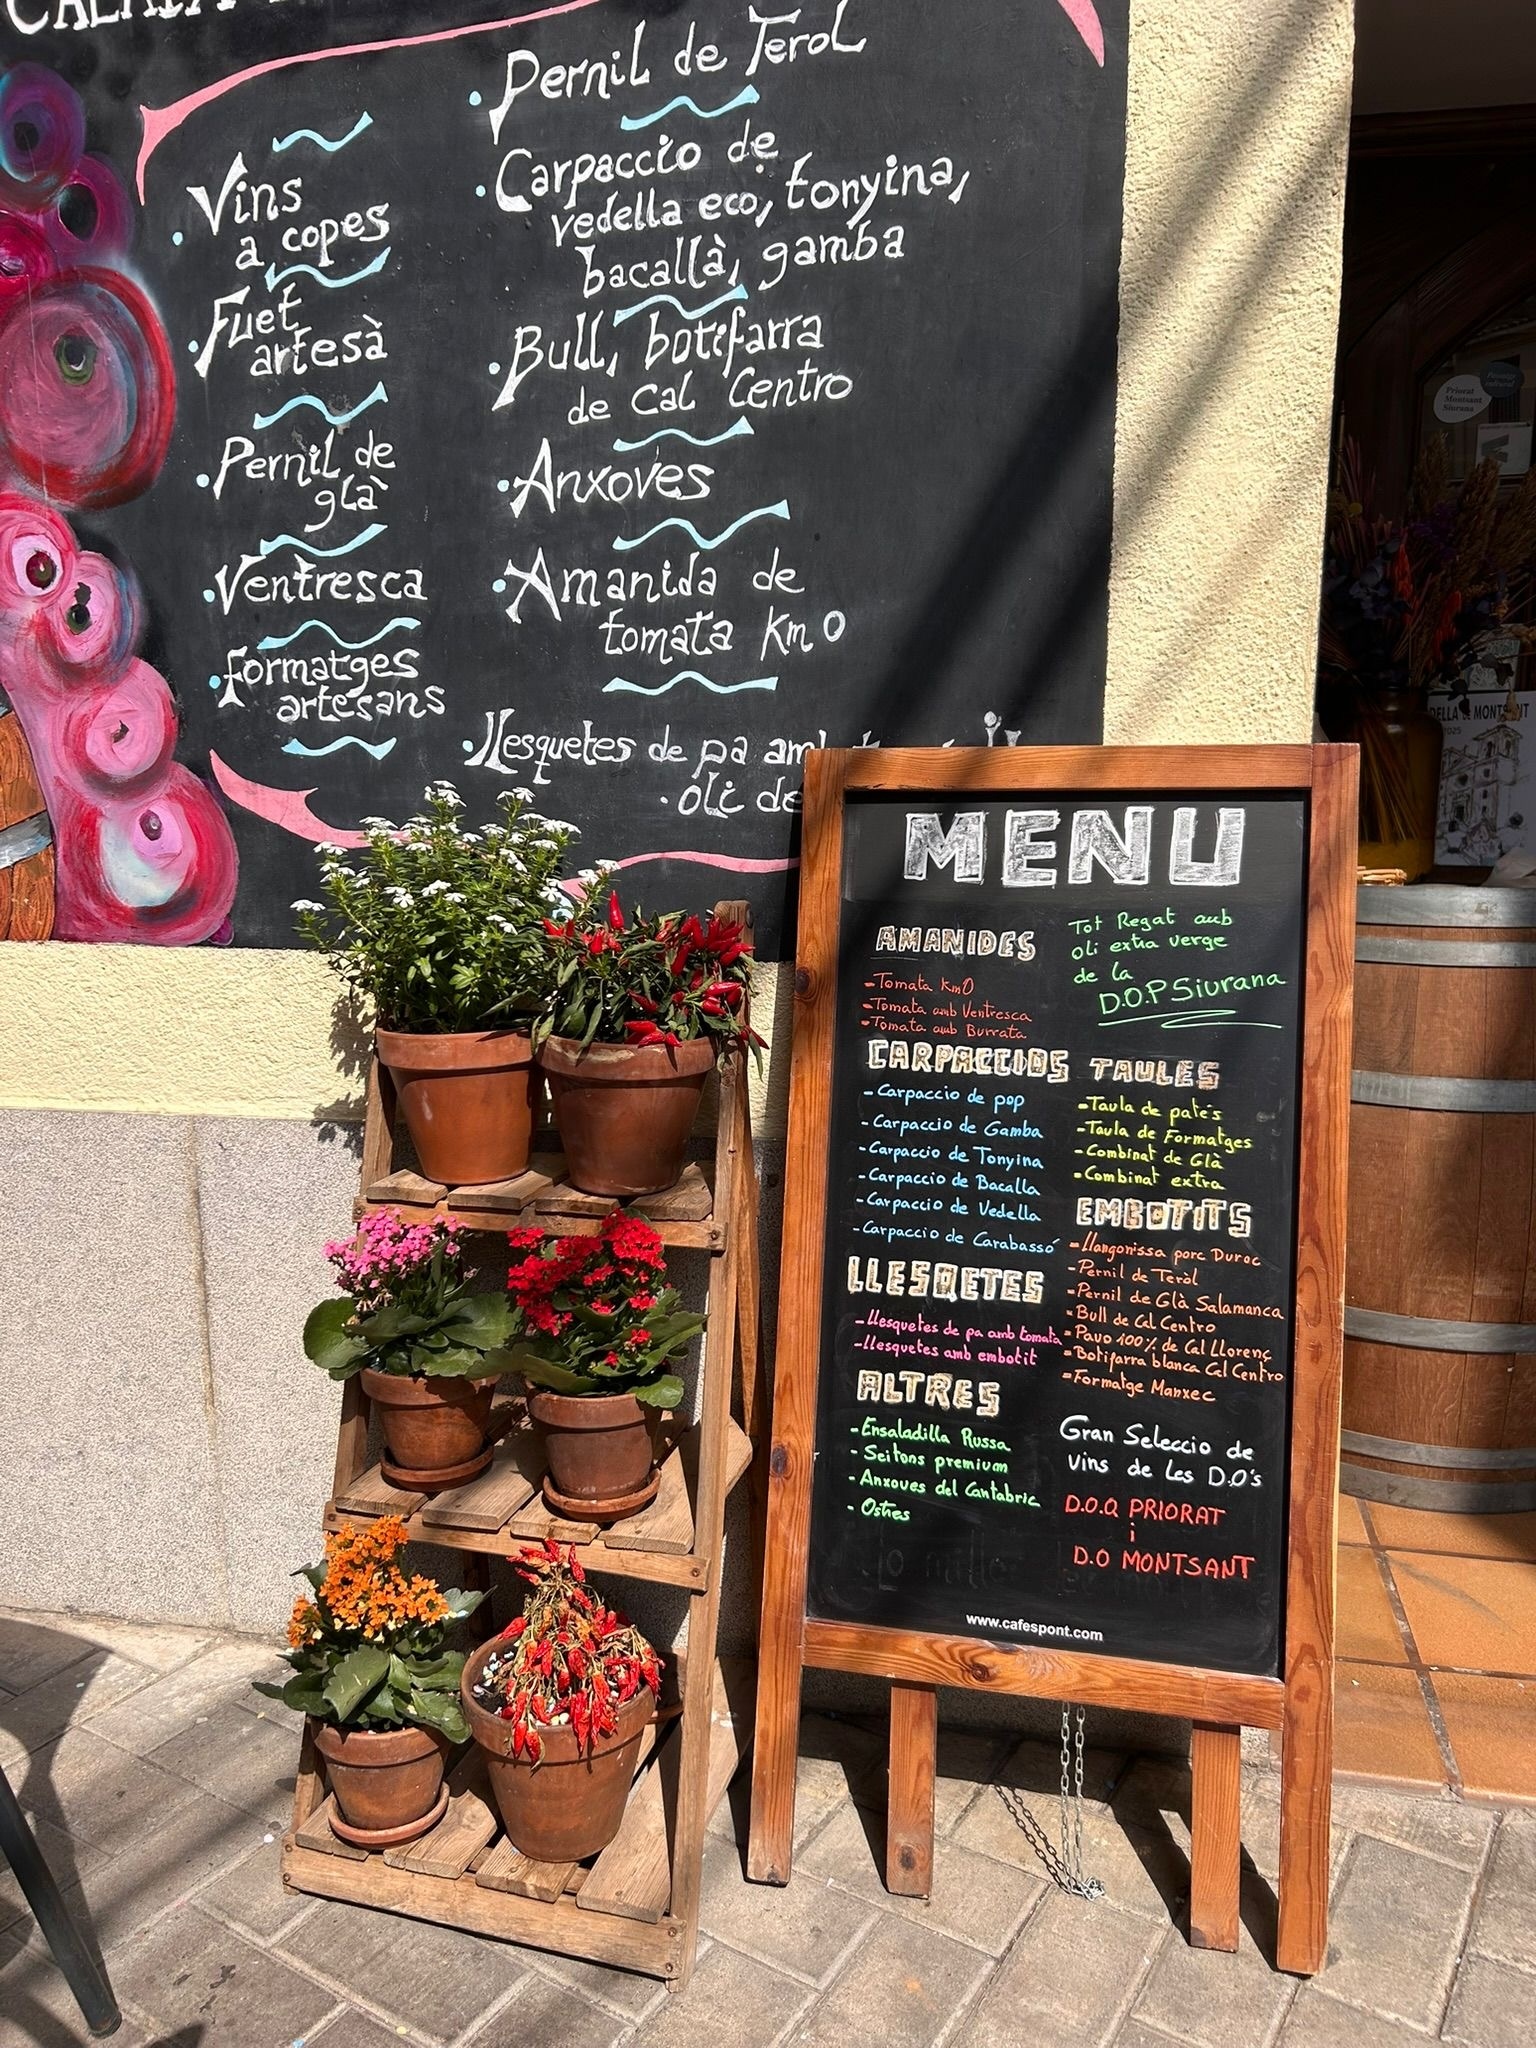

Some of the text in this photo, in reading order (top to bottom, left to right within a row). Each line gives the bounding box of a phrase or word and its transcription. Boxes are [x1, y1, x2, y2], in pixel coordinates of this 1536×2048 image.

[673, 20, 727, 76] de
[495, 118, 779, 212] Carpaccio de
[186, 151, 302, 235] Vins
[550, 188, 683, 247] vedella
[234, 201, 391, 270] a copes
[758, 218, 905, 291] gamba
[194, 281, 303, 377] Fuet
[644, 304, 824, 378] botifarra
[249, 313, 388, 377] artesà
[567, 385, 612, 425] de
[727, 357, 853, 409] Centro
[211, 427, 396, 500] Pernil de
[508, 437, 714, 518] Anxoves
[302, 472, 389, 532] glà
[213, 553, 428, 615] Ventresca
[503, 546, 805, 624] Amanida de
[598, 607, 733, 664] tomata
[275, 684, 446, 722] artesans
[647, 724, 688, 763] de
[694, 735, 748, 779] pa
[902, 805, 1246, 888] MENU
[1067, 915, 1102, 934] Tot
[1116, 906, 1175, 931] Regat
[875, 925, 1036, 961] AMANIDES
[1109, 933, 1159, 952] extra
[1168, 934, 1228, 951] verge
[1072, 961, 1133, 983] de la
[961, 999, 1032, 1023] Ventresca
[966, 1021, 1027, 1039] Burrata
[867, 1038, 1069, 1083] CARPACCIOS
[1088, 1057, 1219, 1090] TAULES
[966, 1087, 986, 1104] de
[993, 1094, 1025, 1114] pop
[1140, 1100, 1162, 1117] de
[958, 1115, 977, 1134] de
[983, 1119, 1043, 1139] Gamba
[1136, 1124, 1155, 1139] de
[1162, 1125, 1254, 1153] Formatges
[947, 1144, 969, 1163] de
[972, 1145, 1044, 1171] Tonyina
[1162, 1149, 1183, 1165] de
[951, 1171, 969, 1188] de
[975, 1173, 1040, 1196] Bacalla
[1169, 1170, 1226, 1190] extra
[949, 1196, 969, 1215] de
[978, 1199, 1041, 1222] Vedella
[1075, 1196, 1251, 1238] EMBOTITS
[944, 1227, 964, 1244] de
[1173, 1248, 1206, 1265] porc
[1210, 1247, 1261, 1267] Duroc
[846, 1255, 1044, 1304] LLESQETES
[1130, 1269, 1148, 1283] de
[1129, 1291, 1151, 1305] de
[1154, 1291, 1189, 1309] Glà
[1194, 1292, 1284, 1320] Salamanca
[942, 1319, 960, 1335] de
[965, 1326, 983, 1342] pa
[987, 1323, 1015, 1339] amb
[1018, 1325, 1063, 1345] tomata
[1112, 1311, 1129, 1327] de
[1133, 1312, 1156, 1330] Cal
[1159, 1315, 1216, 1333] Centro
[943, 1345, 971, 1360] amb
[977, 1346, 1038, 1365] embotit
[1161, 1339, 1178, 1352] de
[1183, 1338, 1205, 1355] Cal
[1152, 1352, 1200, 1374] blanca
[1204, 1359, 1227, 1378] Cal
[1231, 1360, 1284, 1383] Centro
[856, 1368, 1000, 1417] ALTRES
[1150, 1378, 1216, 1402] Manxec
[959, 1426, 1012, 1452] Russa
[1058, 1414, 1255, 1461] Gran Seleccio de
[934, 1454, 1009, 1474] premium
[1126, 1457, 1153, 1479] de
[934, 1480, 958, 1497] del
[964, 1480, 1042, 1507] Cantabric
[1128, 1497, 1226, 1525] PRIORAT
[1120, 1549, 1255, 1579] MONTSANT
[965, 1612, 1104, 1642] www.cafespont.com
